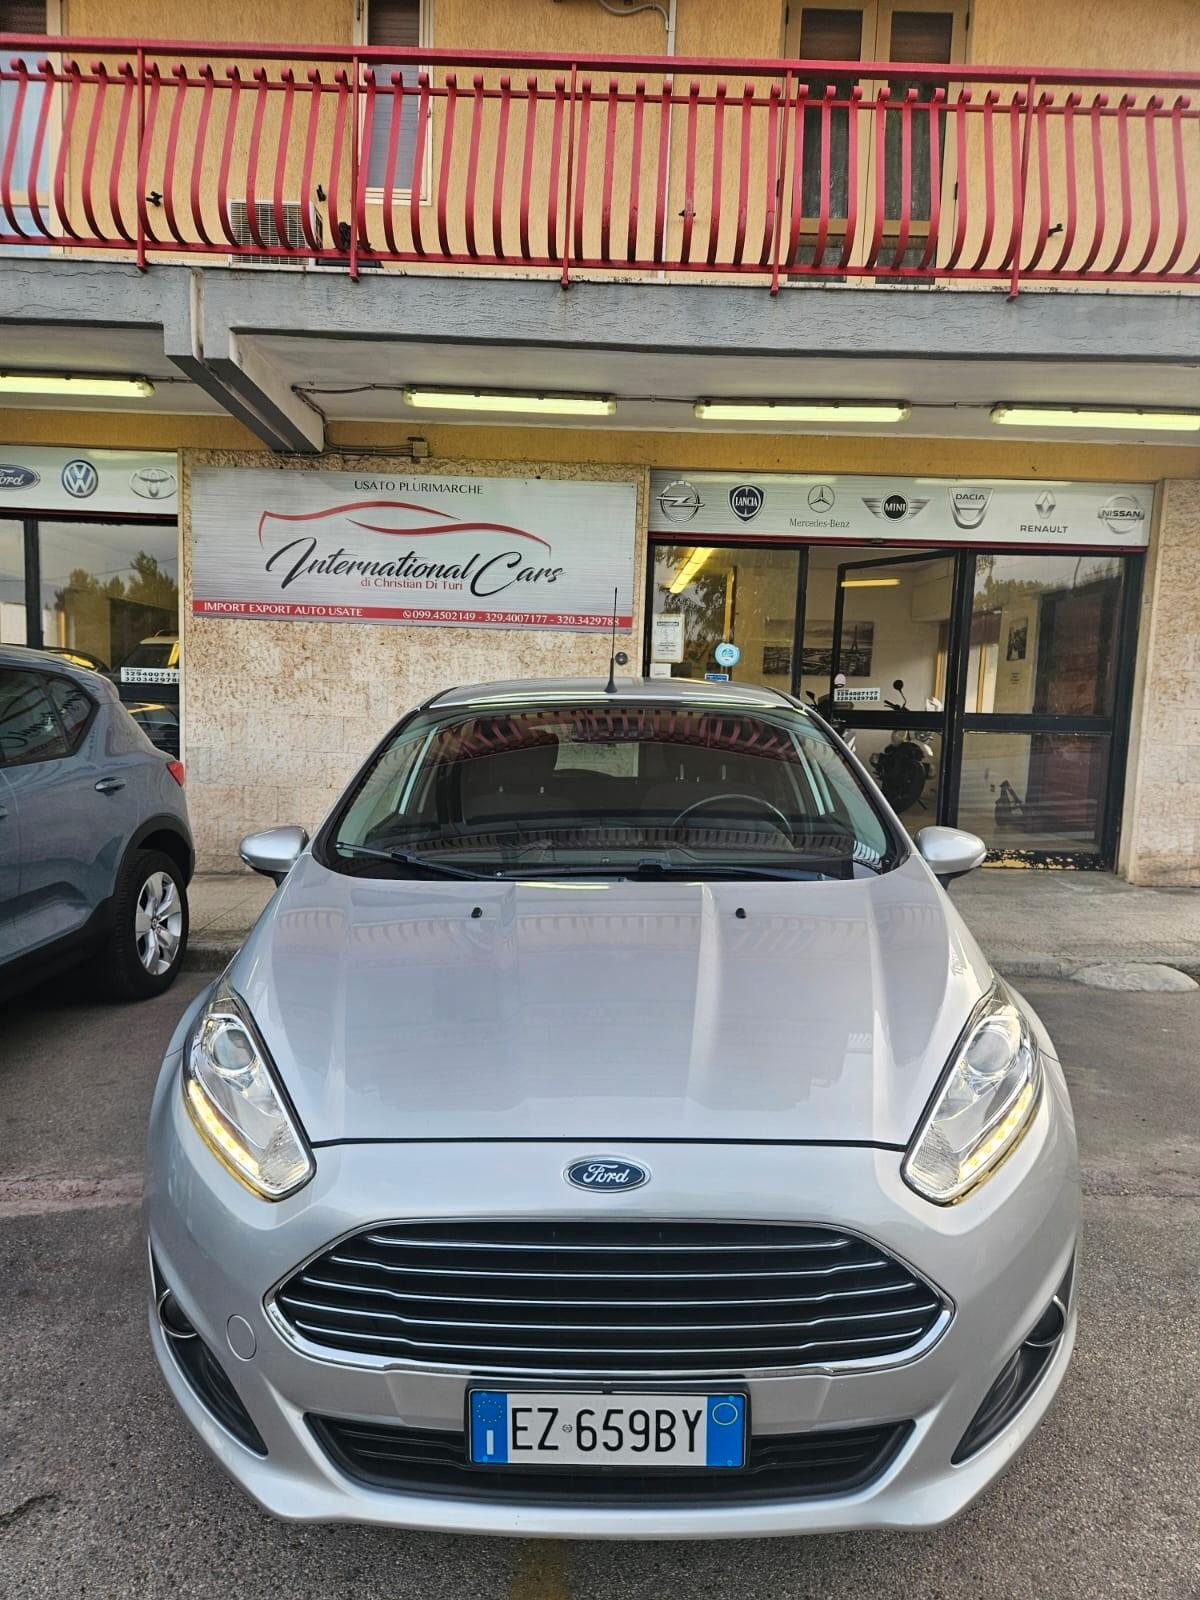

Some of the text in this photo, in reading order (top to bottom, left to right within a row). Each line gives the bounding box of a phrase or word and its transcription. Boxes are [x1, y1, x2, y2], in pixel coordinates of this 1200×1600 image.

[354, 480, 484, 495] USATO PLURIMARCHE
[735, 496, 759, 507] LANCIA
[955, 493, 986, 501] DACIA
[884, 502, 906, 512] MINI
[1102, 510, 1142, 519] NISSAN
[789, 518, 851, 528] Mercedes-Benz
[1020, 524, 1069, 534] RENAULT
[265, 536, 564, 597] International Cars
[360, 578, 463, 591] di Christian Di Turi
[203, 602, 364, 617] IMPORT EXPORT AUTO USATE
[412, 610, 476, 621] 099.4502149
[485, 613, 548, 624] 329.4007177
[582, 1163, 630, 1183] Ford
[511, 1407, 703, 1453] EZ 659BY
